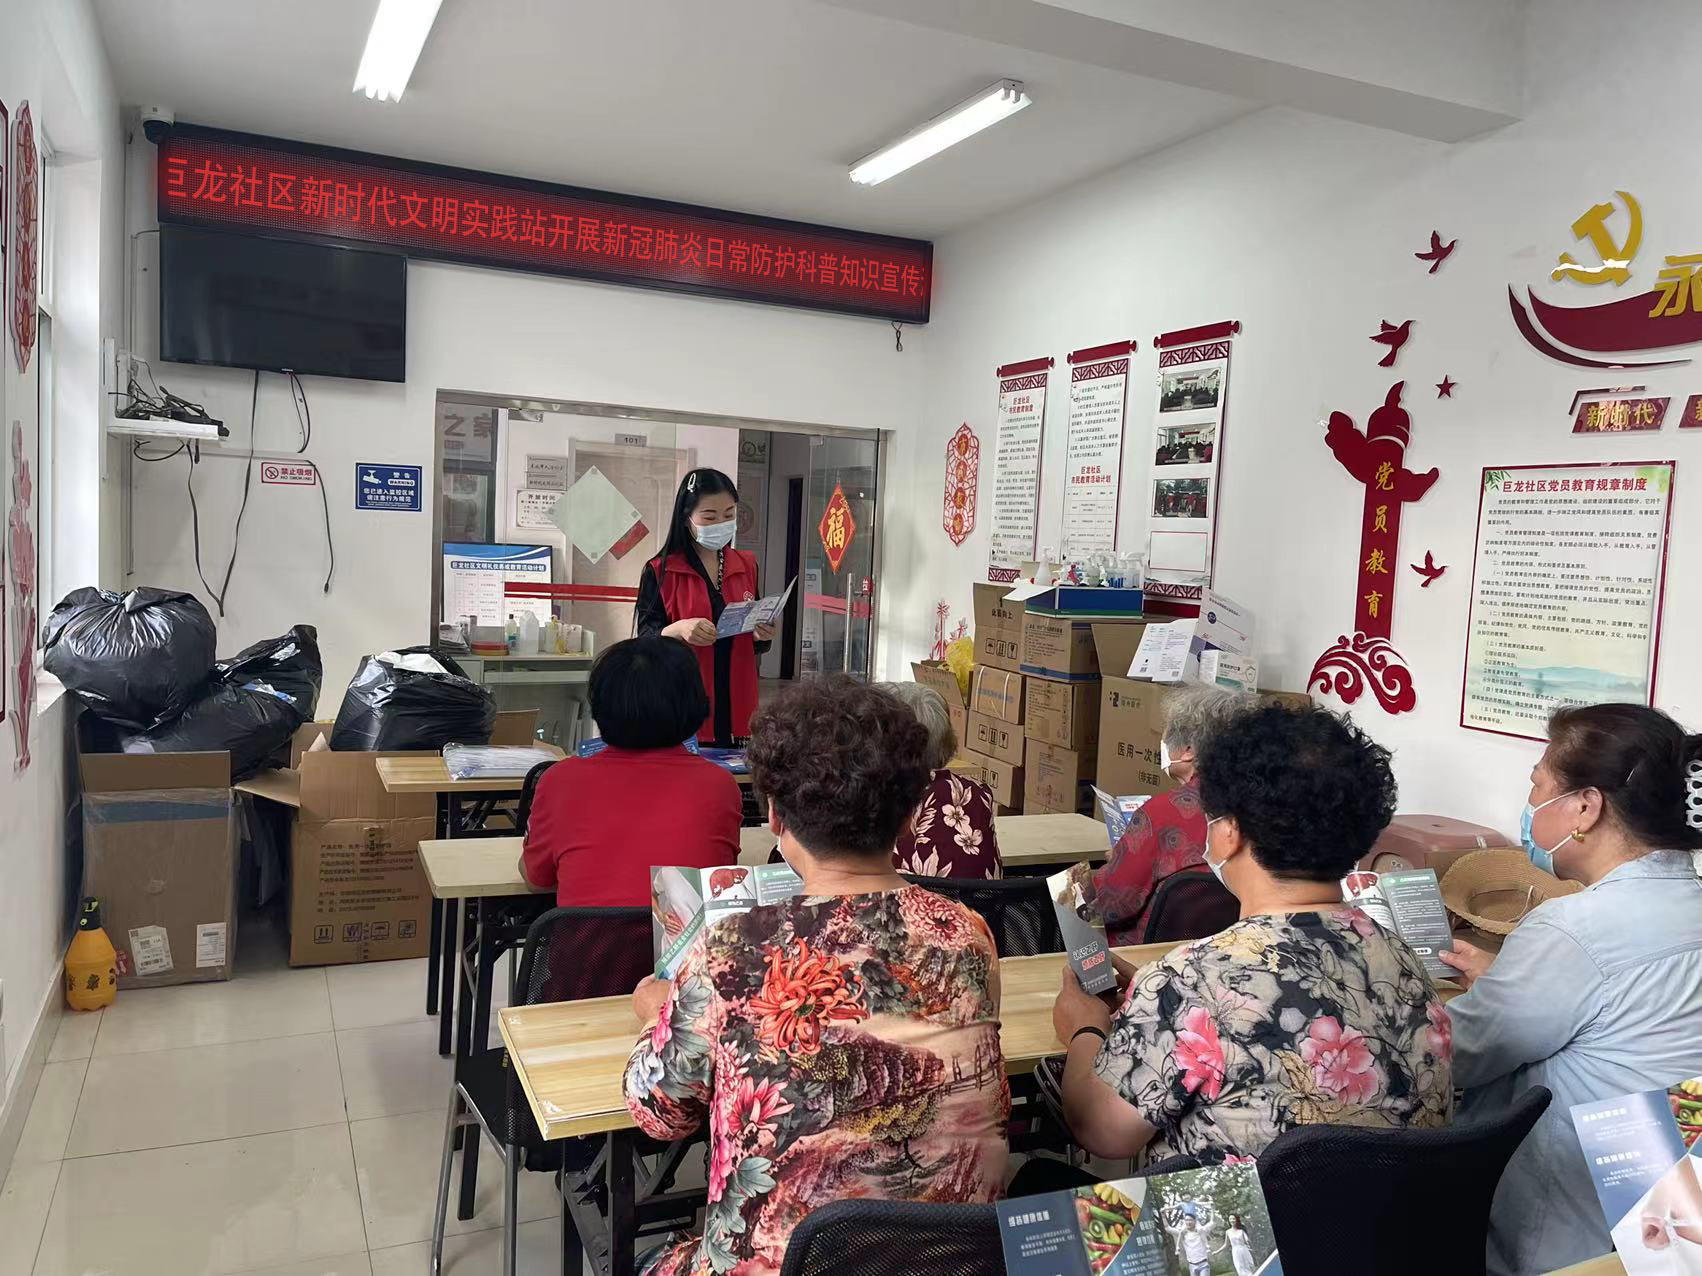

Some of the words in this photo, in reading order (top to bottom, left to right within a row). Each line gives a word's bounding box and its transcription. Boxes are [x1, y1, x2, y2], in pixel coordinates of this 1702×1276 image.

[168, 157, 925, 297] 巨龙社区新时代文明实践站开展新冠肺炎日常防护科普知识宣传
[624, 436, 639, 445] 101
[280, 467, 313, 477] 禁止吸烟
[1502, 477, 1648, 493] 巨龙社区党员教育规章制度
[827, 507, 845, 549] 福
[1364, 461, 1395, 618] 党员教育
